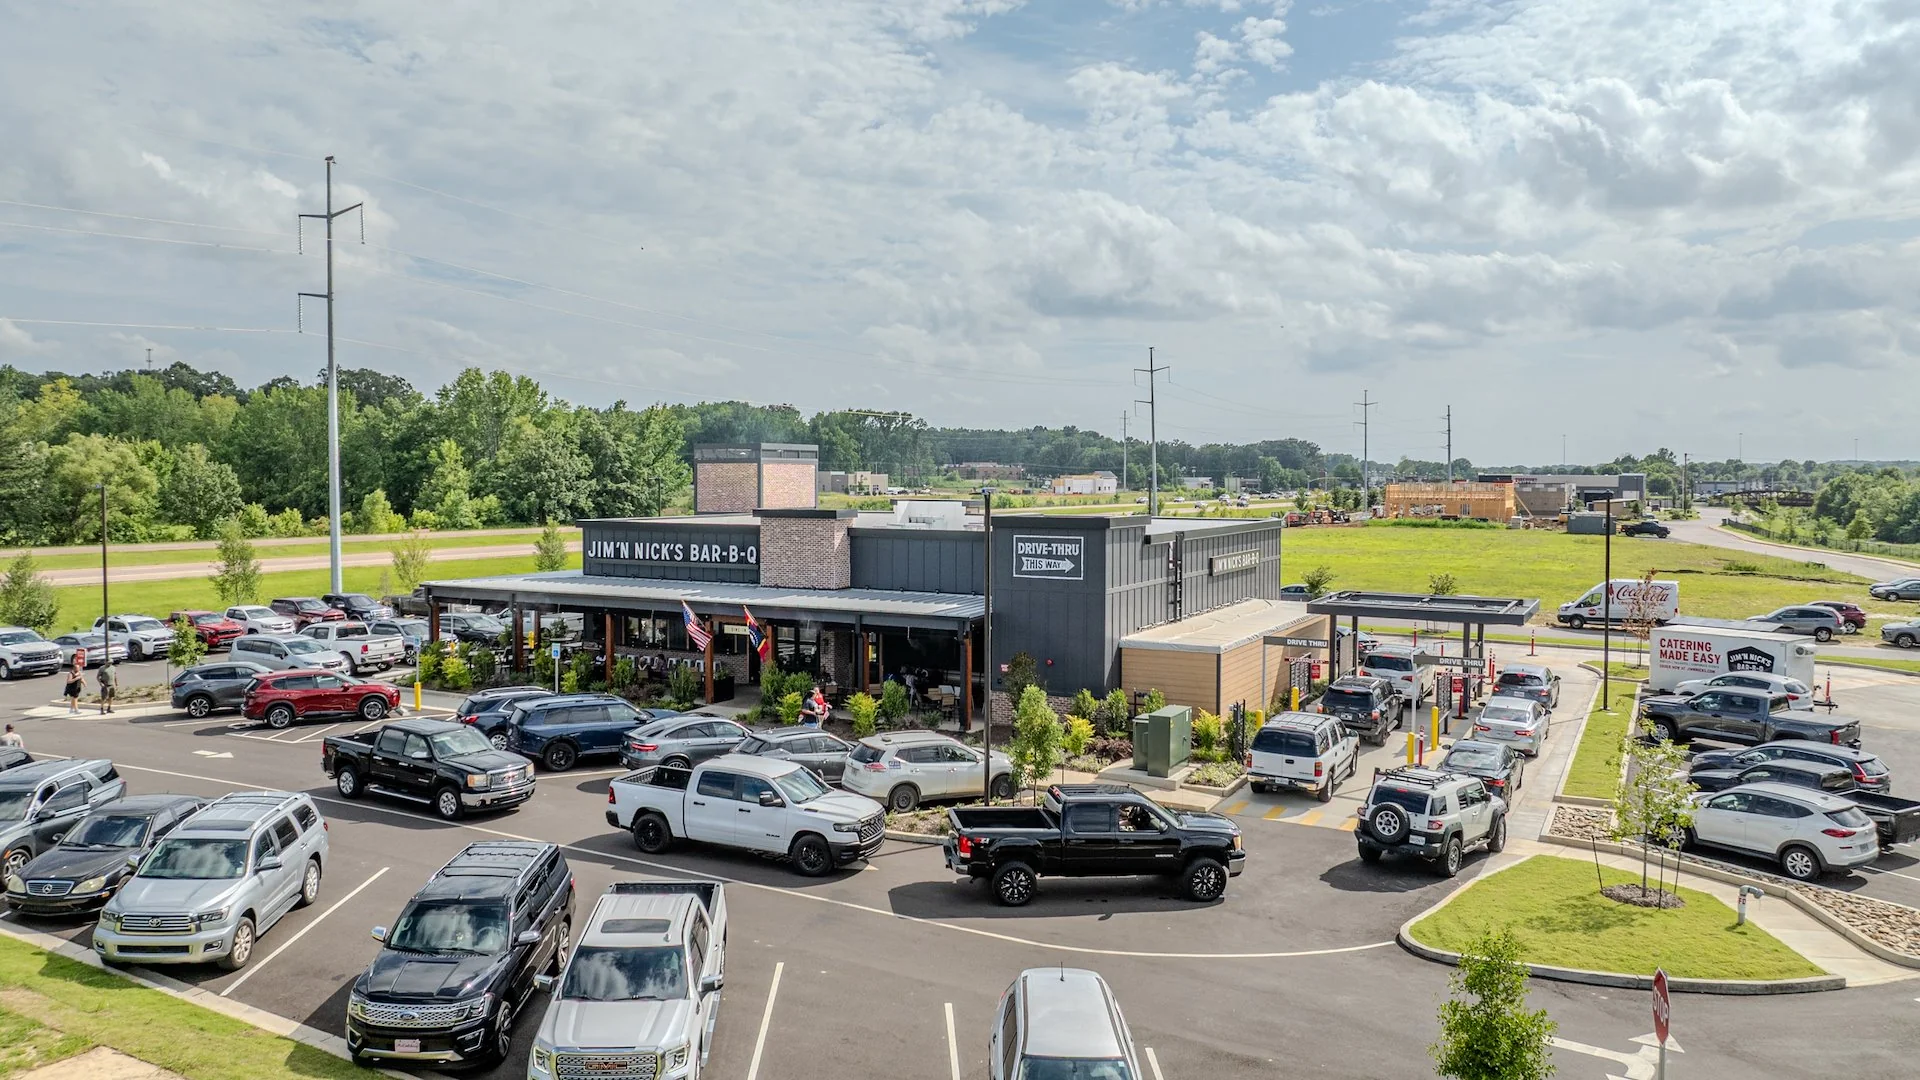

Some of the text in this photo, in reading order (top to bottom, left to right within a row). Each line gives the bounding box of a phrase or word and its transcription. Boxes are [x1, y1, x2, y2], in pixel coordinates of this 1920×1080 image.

[588, 540, 757, 564] JIM'N NICK'S BAR-B-Q
[1018, 542, 1080, 556] DRIVE-THRU
[1025, 559, 1061, 569] THIS WAY
[1617, 584, 1670, 602] CocaCola
[1286, 638, 1307, 646] DRIVE
[1660, 638, 1711, 652] CATERING
[1439, 657, 1484, 667] DRIVE THRU
[1660, 650, 1720, 664] MADE EASY
[1730, 653, 1749, 663] JIM'N
[1749, 654, 1772, 667] NICK'S
[1737, 663, 1764, 671] BAR-B-Q
[1653, 986, 1668, 1027] STOP
